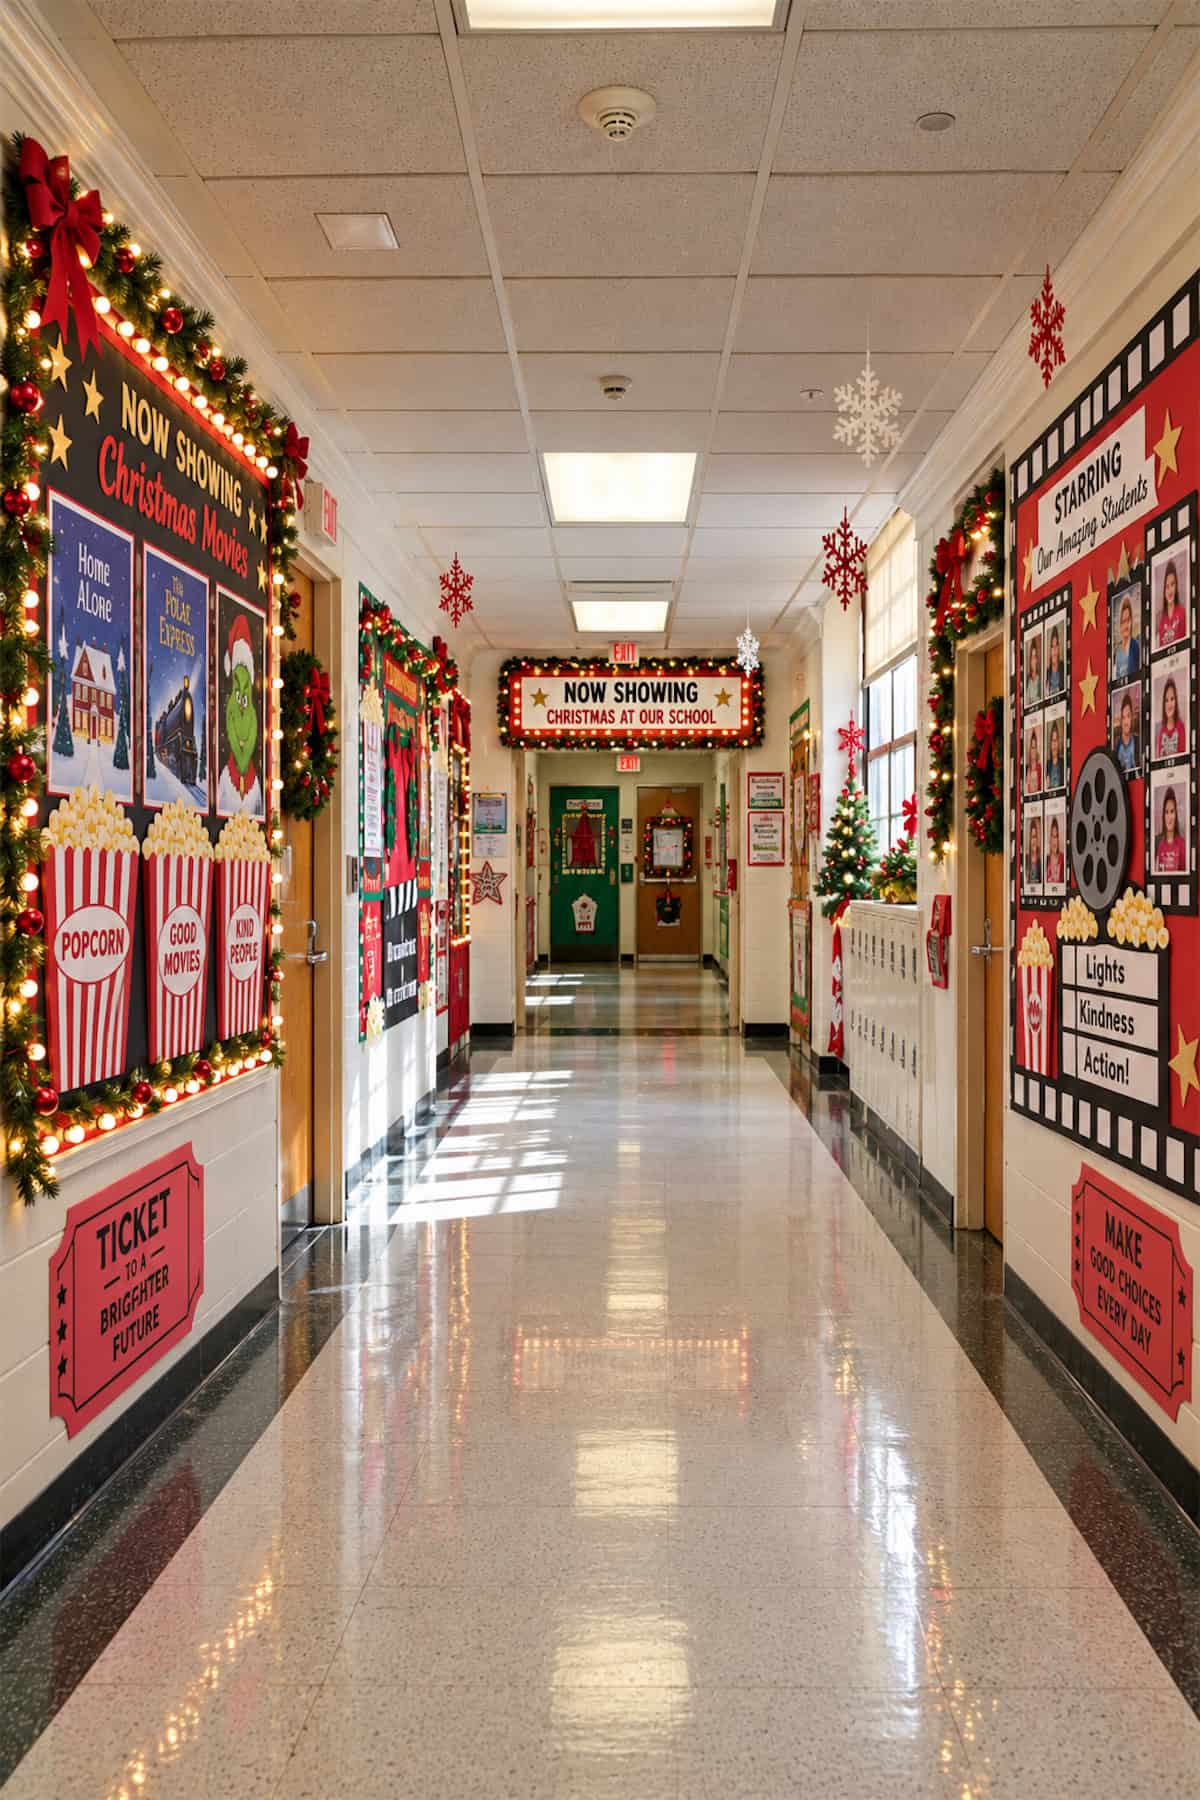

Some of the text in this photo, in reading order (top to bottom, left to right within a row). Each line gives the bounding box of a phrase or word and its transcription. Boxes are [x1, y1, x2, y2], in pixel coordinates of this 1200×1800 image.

[122, 381, 242, 518] NOW SHOWING
[1055, 441, 1121, 525] STARRING
[99, 435, 248, 578] Christmas Movies
[1037, 473, 1148, 575] Our Amazing Students
[78, 542, 111, 587] Home
[564, 682, 698, 704] NOW SHOWING
[547, 709, 716, 725] CHRISTMAS AT OUR SCHOOL
[62, 928, 125, 961] POPCORN
[170, 922, 197, 946] GOOD
[230, 942, 258, 964] PEOPLE
[164, 949, 201, 977] MOVIES
[1086, 954, 1125, 987] Lights
[1080, 1000, 1135, 1035] Kindness
[1084, 1046, 1129, 1086] Action!
[96, 1187, 171, 1271] TICKET
[1105, 1210, 1142, 1269] MAKE
[126, 1252, 147, 1281] TO A
[1090, 1248, 1162, 1326] GOOD CHOICES
[113, 1303, 159, 1362] FUTURE
[1097, 1286, 1151, 1355] EVERY DAY
